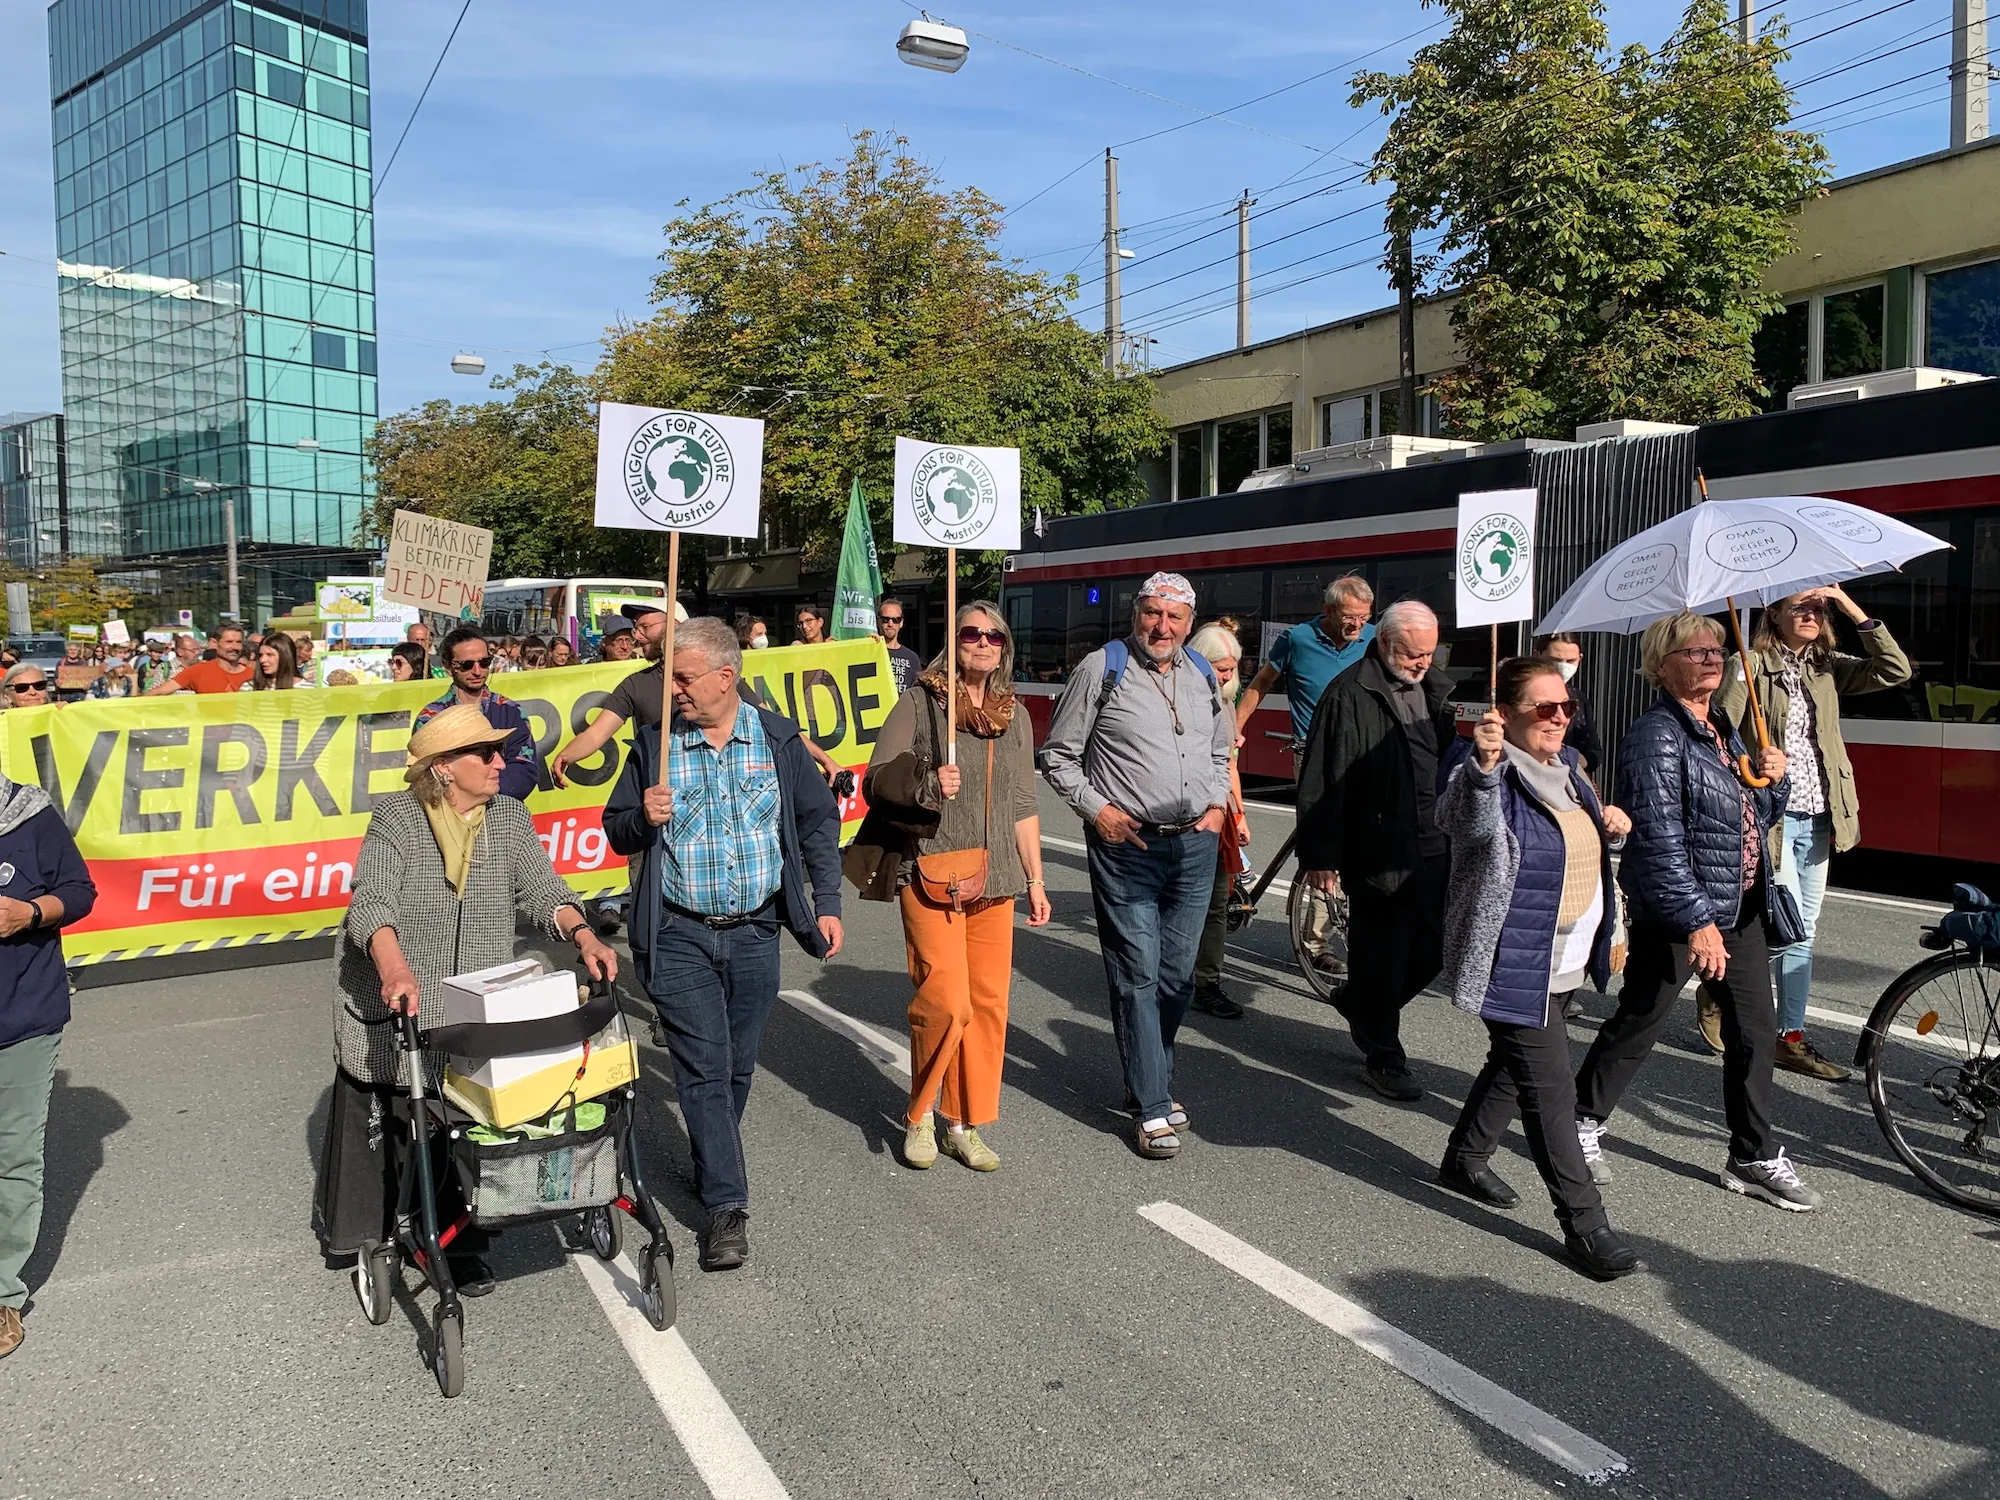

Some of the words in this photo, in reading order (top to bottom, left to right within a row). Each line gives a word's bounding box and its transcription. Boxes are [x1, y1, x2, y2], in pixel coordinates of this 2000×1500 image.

[628, 422, 663, 507] RELIGIONS
[665, 418, 698, 436] FOR
[698, 428, 730, 483] FUTURE
[914, 456, 938, 526] RELIGIONS
[939, 451, 965, 466] FOR
[966, 459, 994, 504] FUTURE
[664, 499, 716, 524] Austria
[394, 517, 486, 559] KLIMAKRISE
[942, 519, 984, 540] Austria
[1725, 526, 1766, 541] OMAS
[1462, 524, 1486, 589] RELIGIONS
[1486, 517, 1508, 530] FOR
[1508, 521, 1529, 561] FUTURE
[1730, 536, 1776, 554] GEGEN
[405, 545, 475, 574] BETRIFFT
[1630, 549, 1664, 565] OMAS
[1732, 546, 1782, 565] RECHTS
[1623, 563, 1659, 579] GEGEN
[1488, 575, 1521, 597] Austria
[1616, 575, 1656, 592] RECHTS
[842, 590, 865, 604] Wir
[1091, 589, 1098, 603] 2
[847, 612, 864, 626] bis
[137, 863, 246, 911] Für
